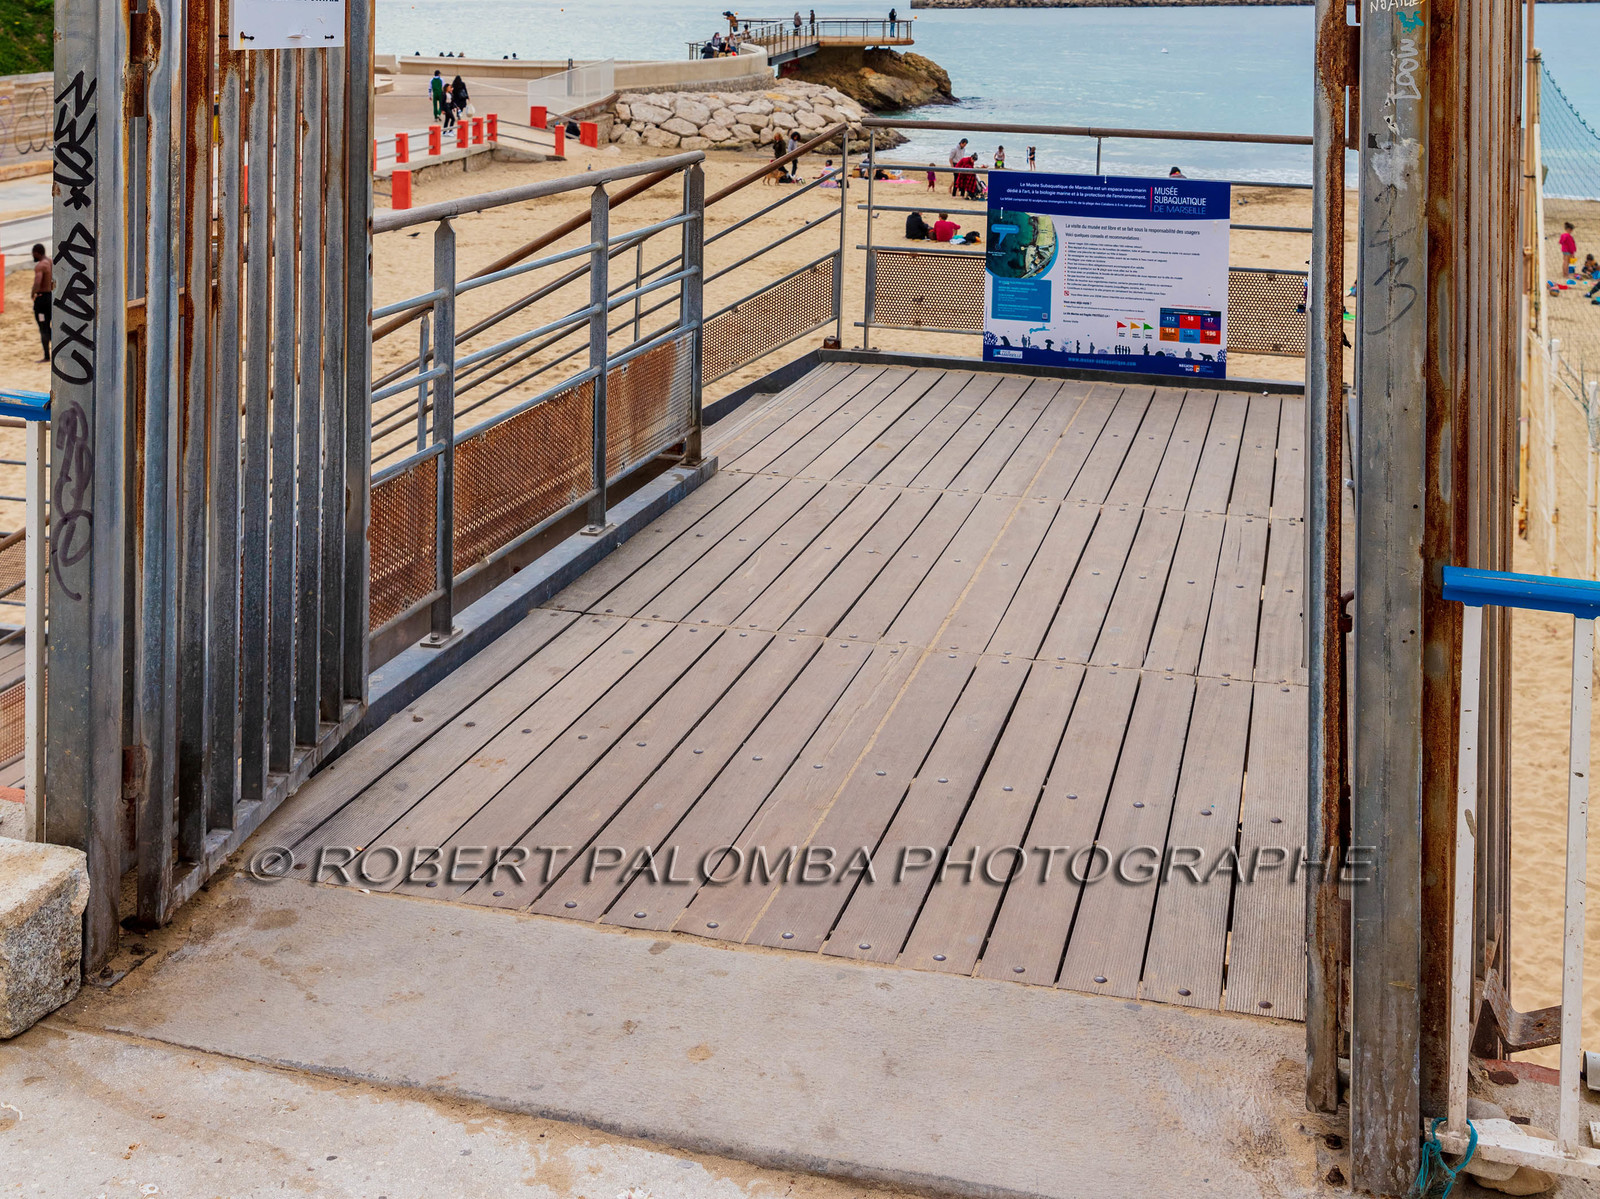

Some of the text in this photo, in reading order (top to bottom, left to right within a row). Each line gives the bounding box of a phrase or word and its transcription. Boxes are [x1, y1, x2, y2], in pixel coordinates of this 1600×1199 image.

[1154, 186, 1178, 196] MUSÉE
[1154, 195, 1206, 206] SUBAQUATIQUE
[1153, 205, 1206, 215] DE MARSEILLE
